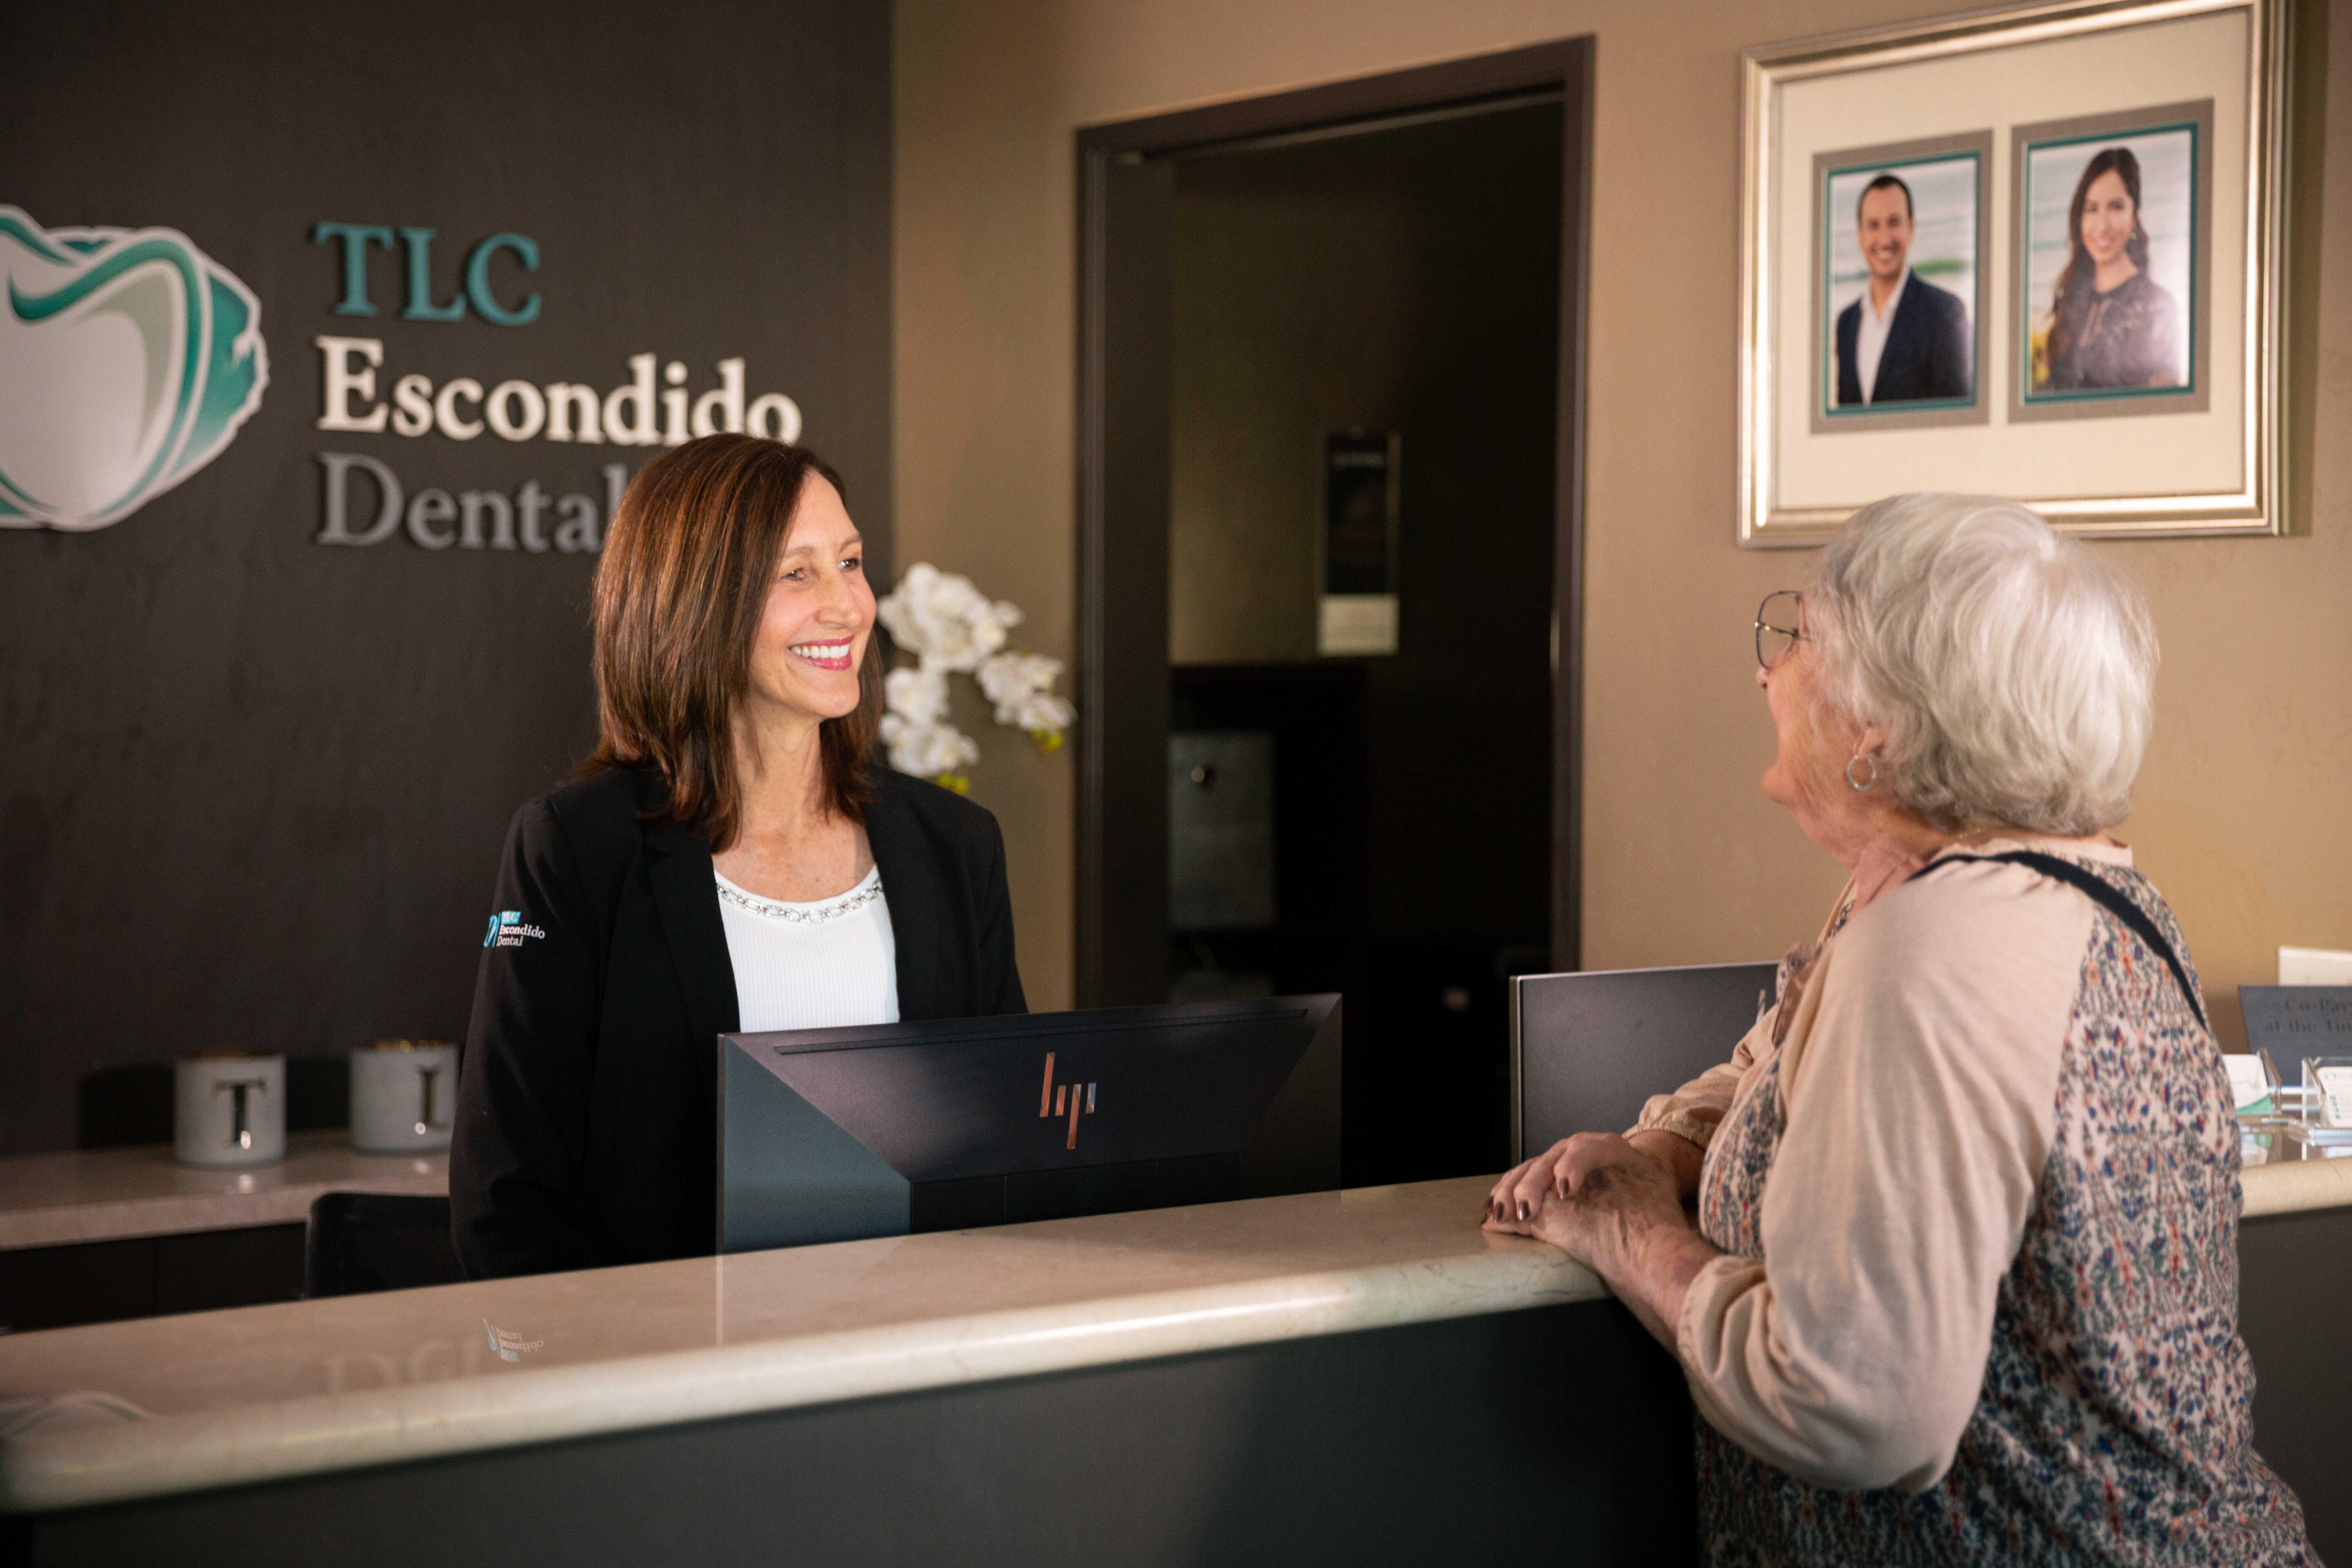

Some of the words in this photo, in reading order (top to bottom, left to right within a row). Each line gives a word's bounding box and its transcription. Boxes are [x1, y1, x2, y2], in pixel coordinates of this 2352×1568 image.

[314, 221, 541, 325] TLC
[316, 336, 802, 446] Escondido
[497, 936, 523, 946] Dental
[212, 1077, 266, 1149] T
[1040, 1052, 1096, 1149] hp
